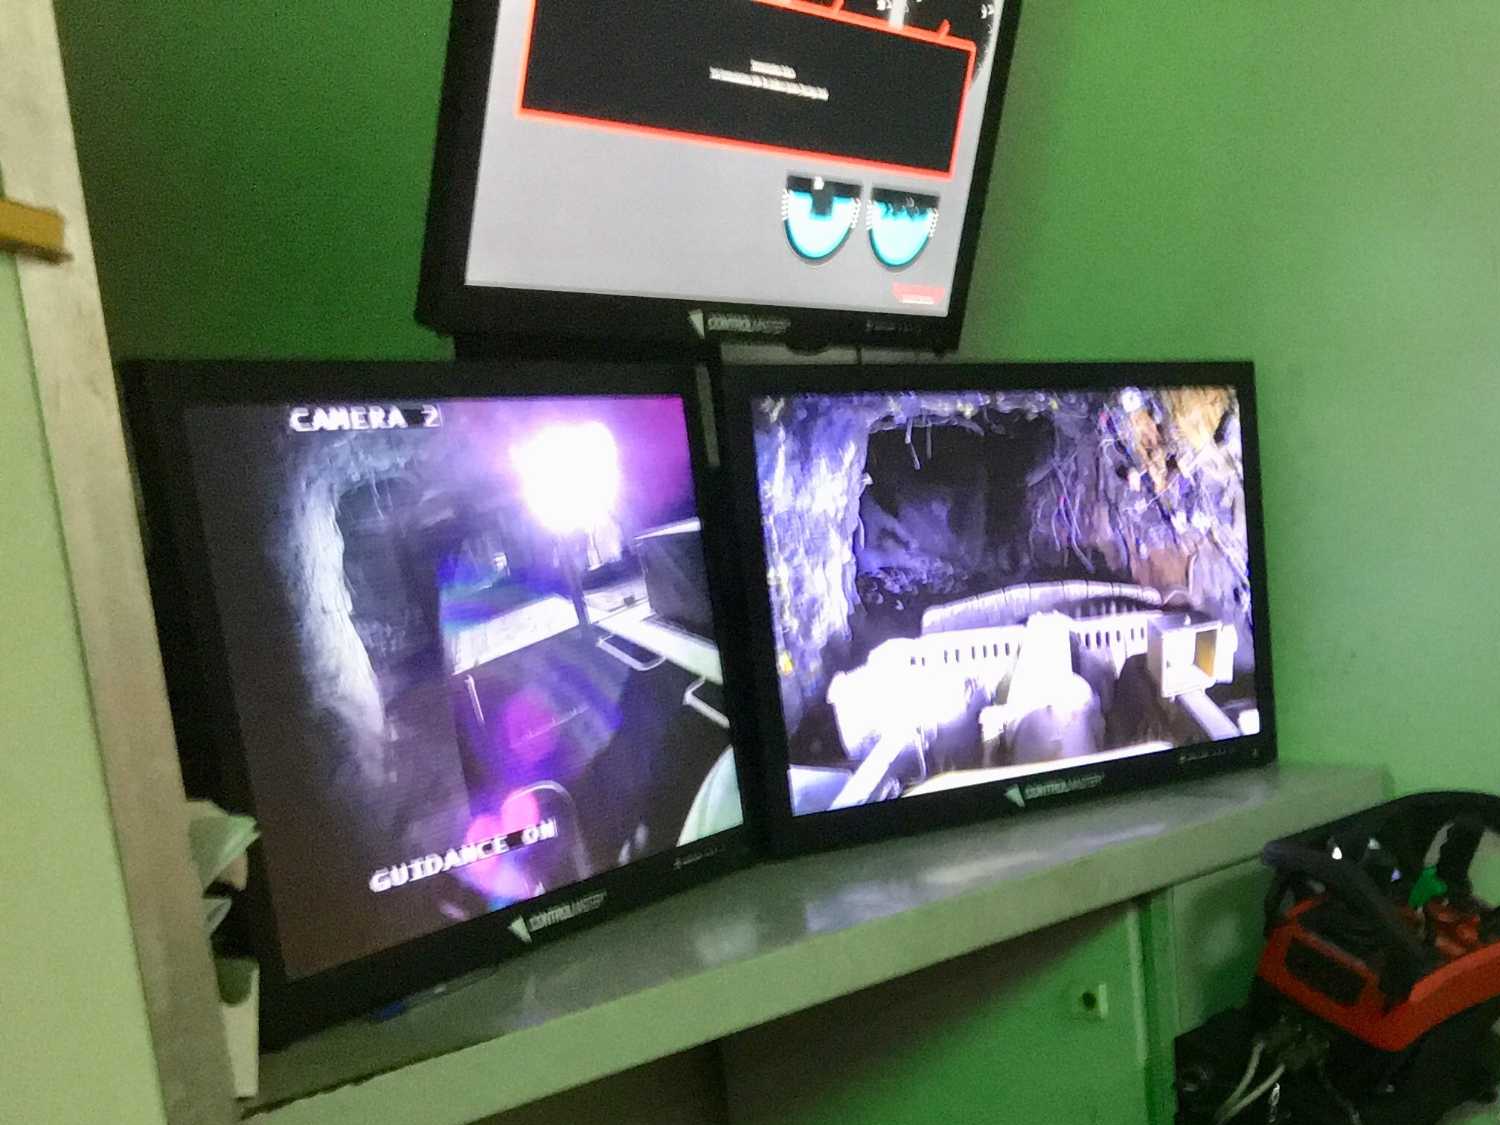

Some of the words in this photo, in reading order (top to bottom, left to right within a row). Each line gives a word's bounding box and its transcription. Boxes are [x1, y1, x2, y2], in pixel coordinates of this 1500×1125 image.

[290, 405, 408, 432] CAMERA
[421, 404, 441, 428] 2
[368, 836, 509, 893] GUIDANCE
[522, 818, 557, 845] ON
